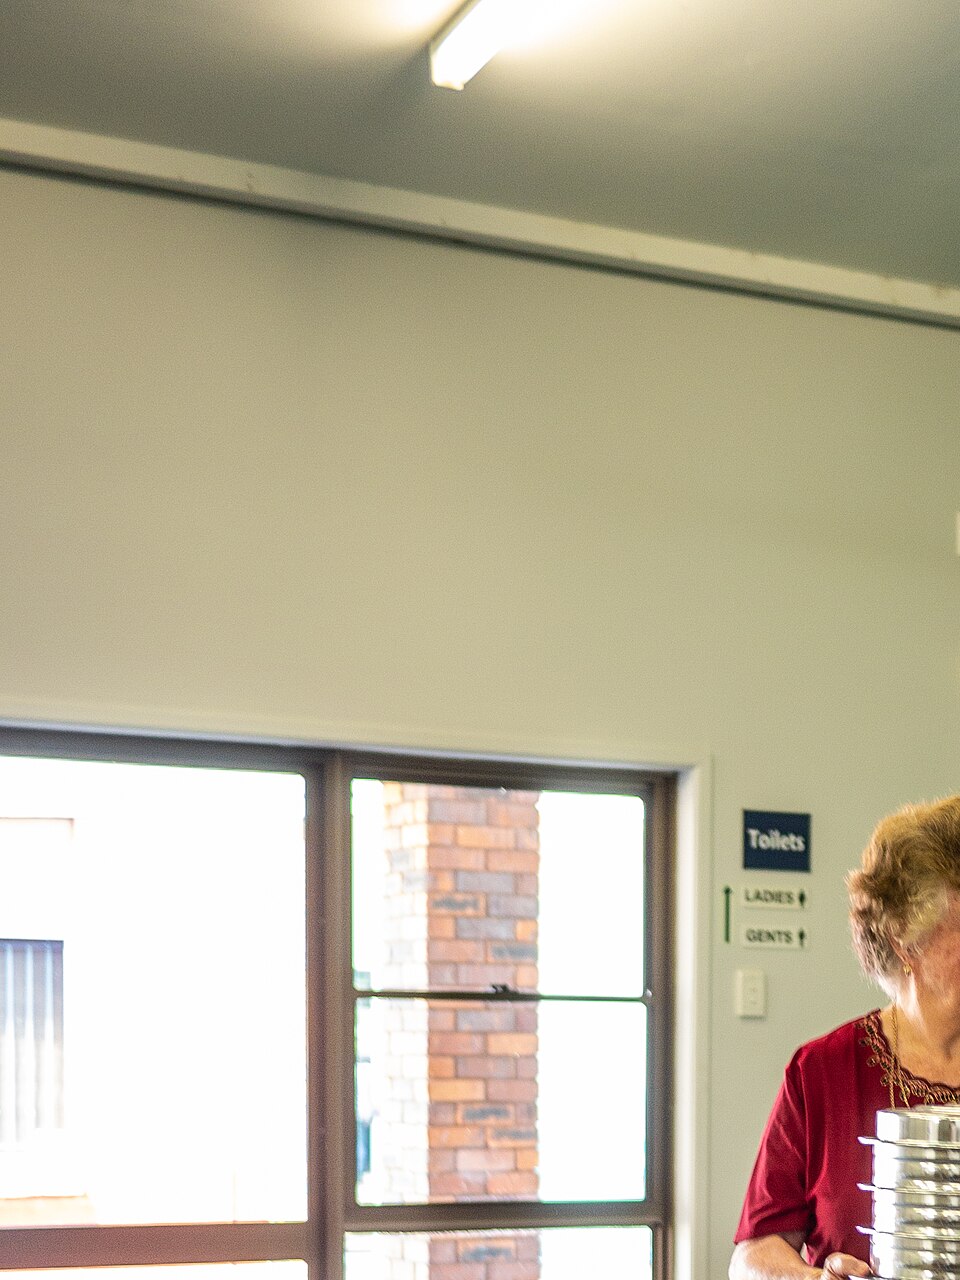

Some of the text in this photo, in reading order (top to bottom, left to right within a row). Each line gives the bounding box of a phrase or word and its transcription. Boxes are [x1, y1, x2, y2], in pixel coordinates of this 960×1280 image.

[747, 828, 805, 851] Toilets
[745, 889, 794, 903] LADIES
[746, 929, 793, 943] GENTS
